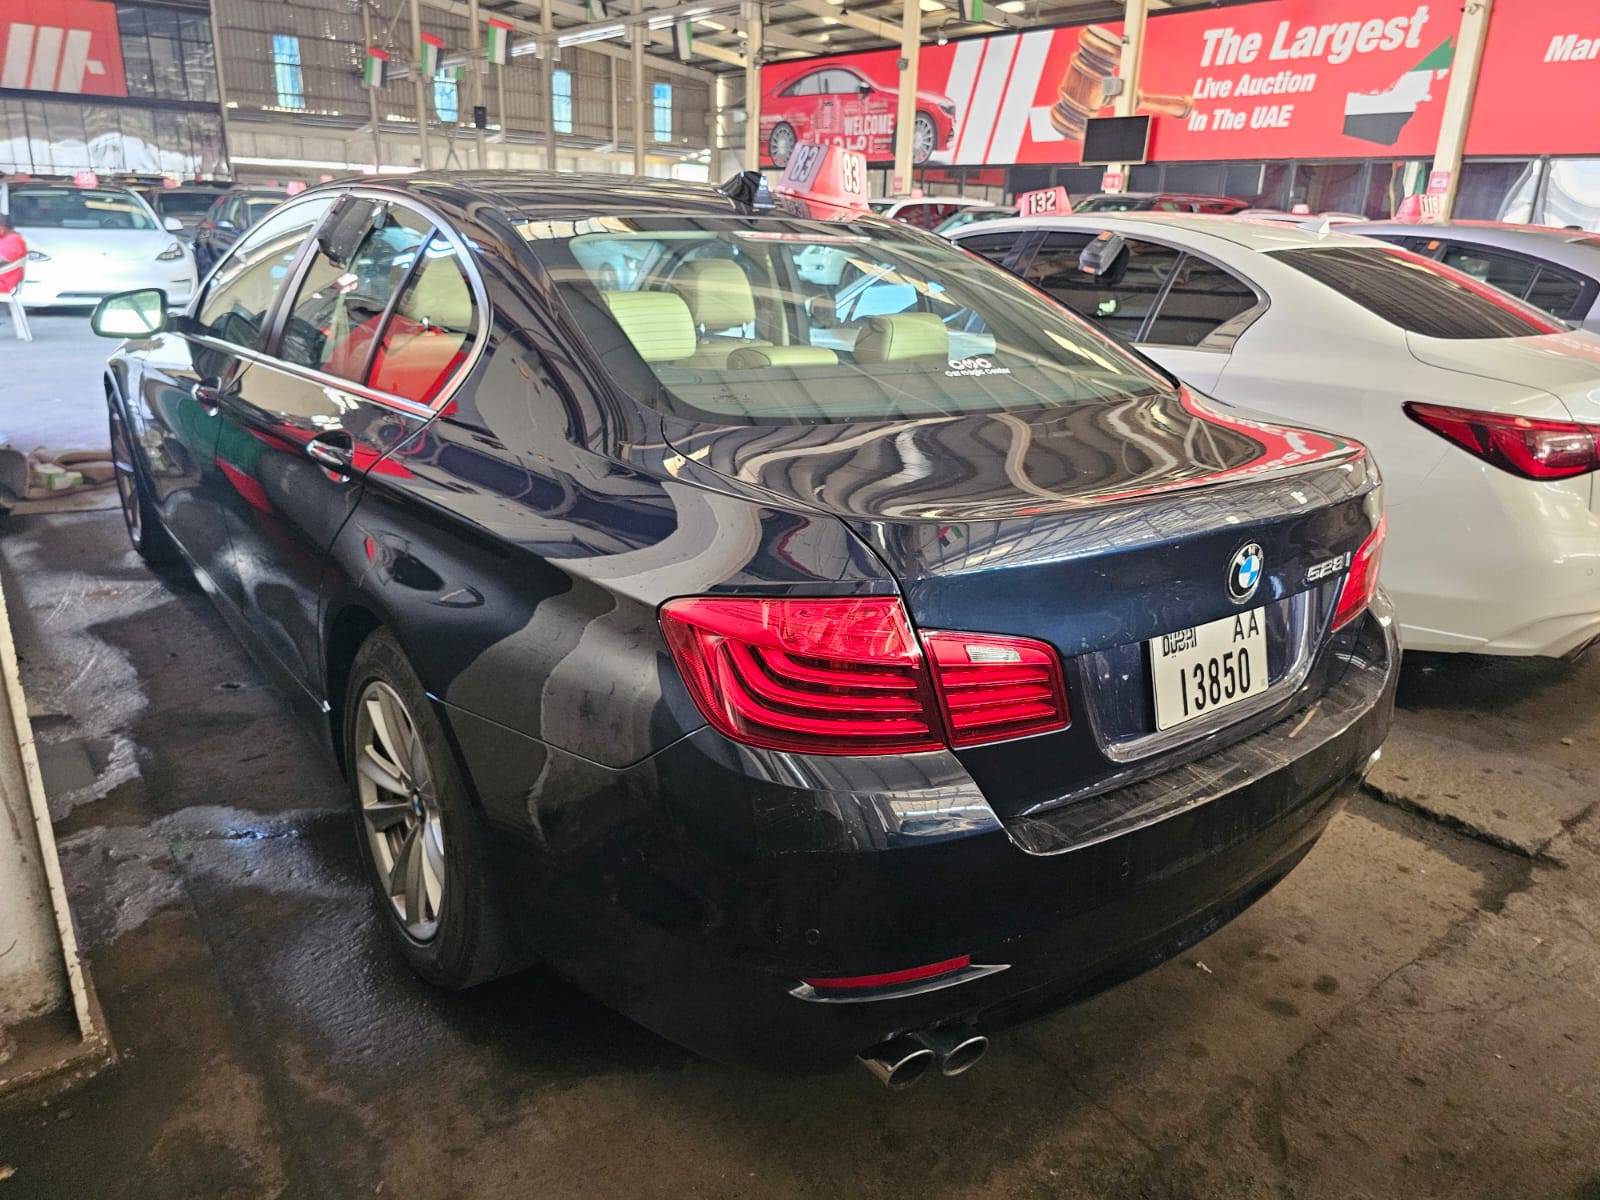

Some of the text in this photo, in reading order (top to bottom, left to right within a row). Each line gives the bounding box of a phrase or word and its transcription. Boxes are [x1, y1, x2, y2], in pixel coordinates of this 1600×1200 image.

[1200, 4, 1430, 68] The Largest
[1192, 70, 1317, 99] Live Auction
[843, 113, 896, 136] WELCOME
[1187, 104, 1295, 132] In The UAE
[789, 144, 820, 183] 83
[843, 152, 862, 194] 83
[1029, 190, 1057, 214] 132
[1180, 647, 1251, 717] 13850
